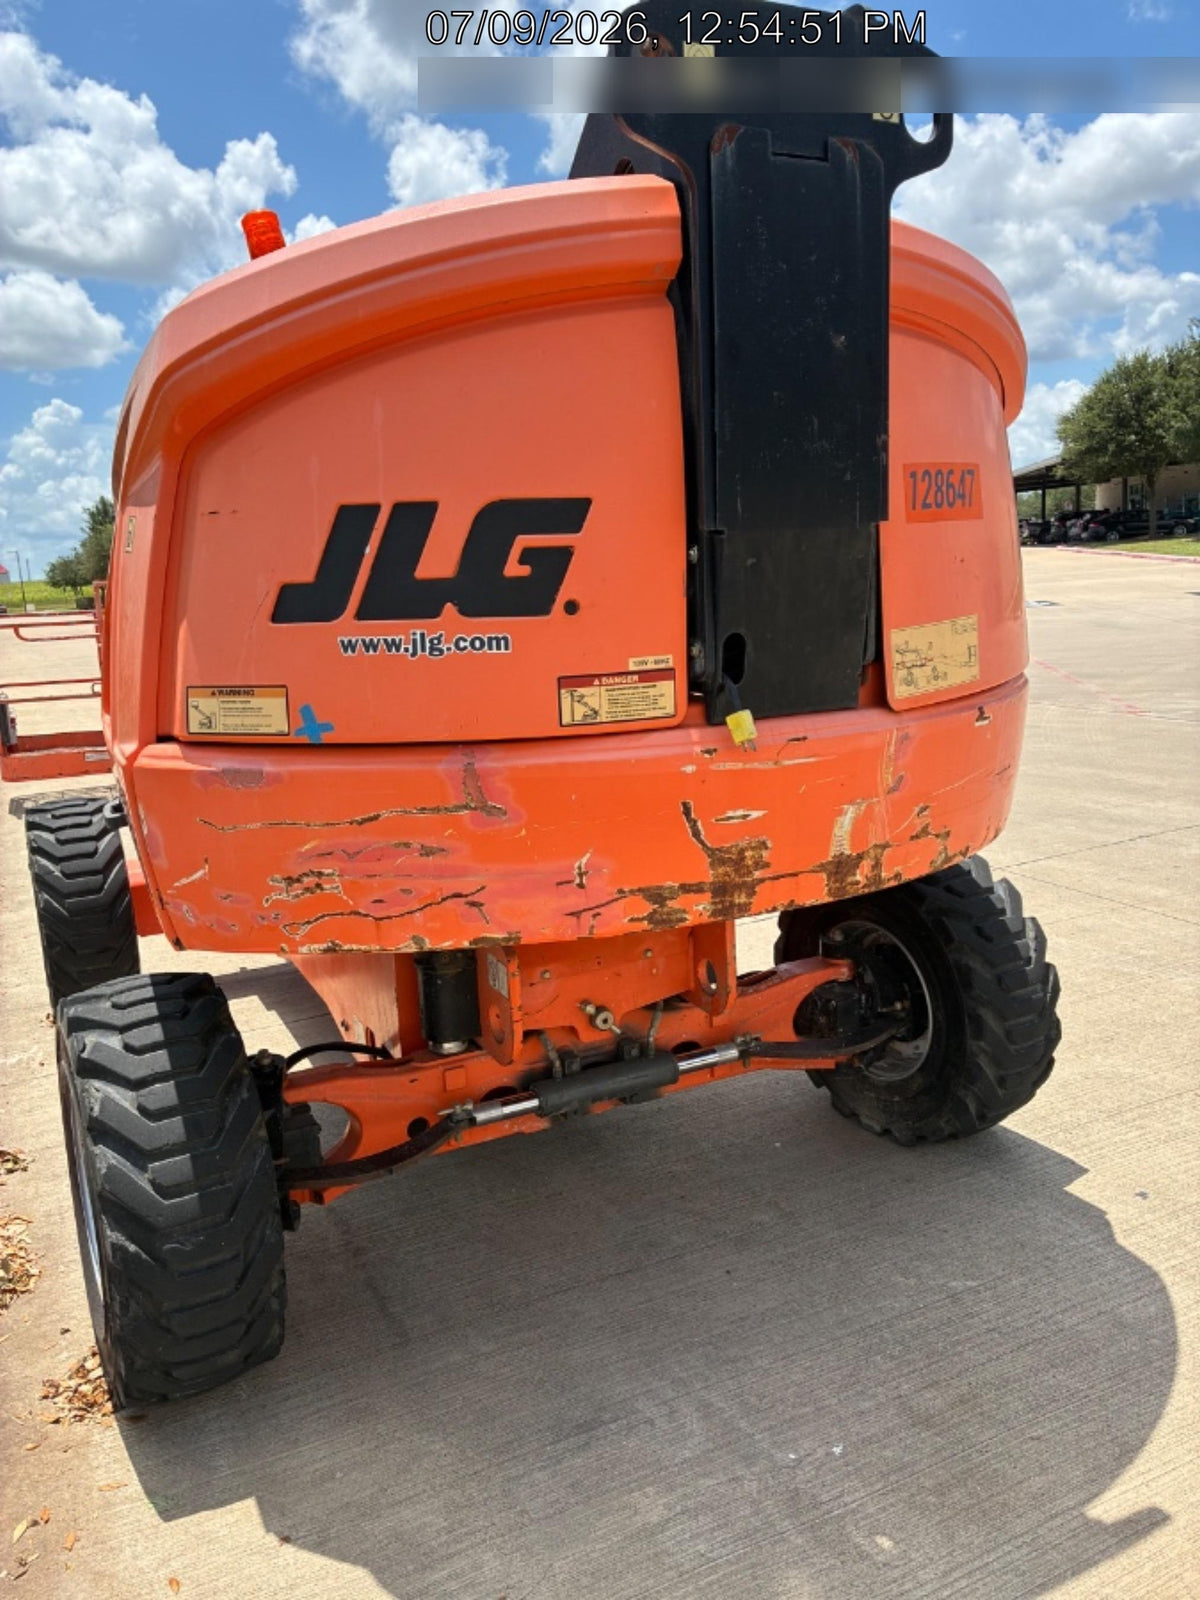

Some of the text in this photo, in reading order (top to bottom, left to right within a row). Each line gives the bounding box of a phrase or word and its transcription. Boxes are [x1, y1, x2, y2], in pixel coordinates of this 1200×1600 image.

[909, 468, 975, 511] 128647
[338, 631, 511, 657] www.jlg.com
[601, 675, 639, 685] DANGER
[217, 689, 255, 697] WARNING
